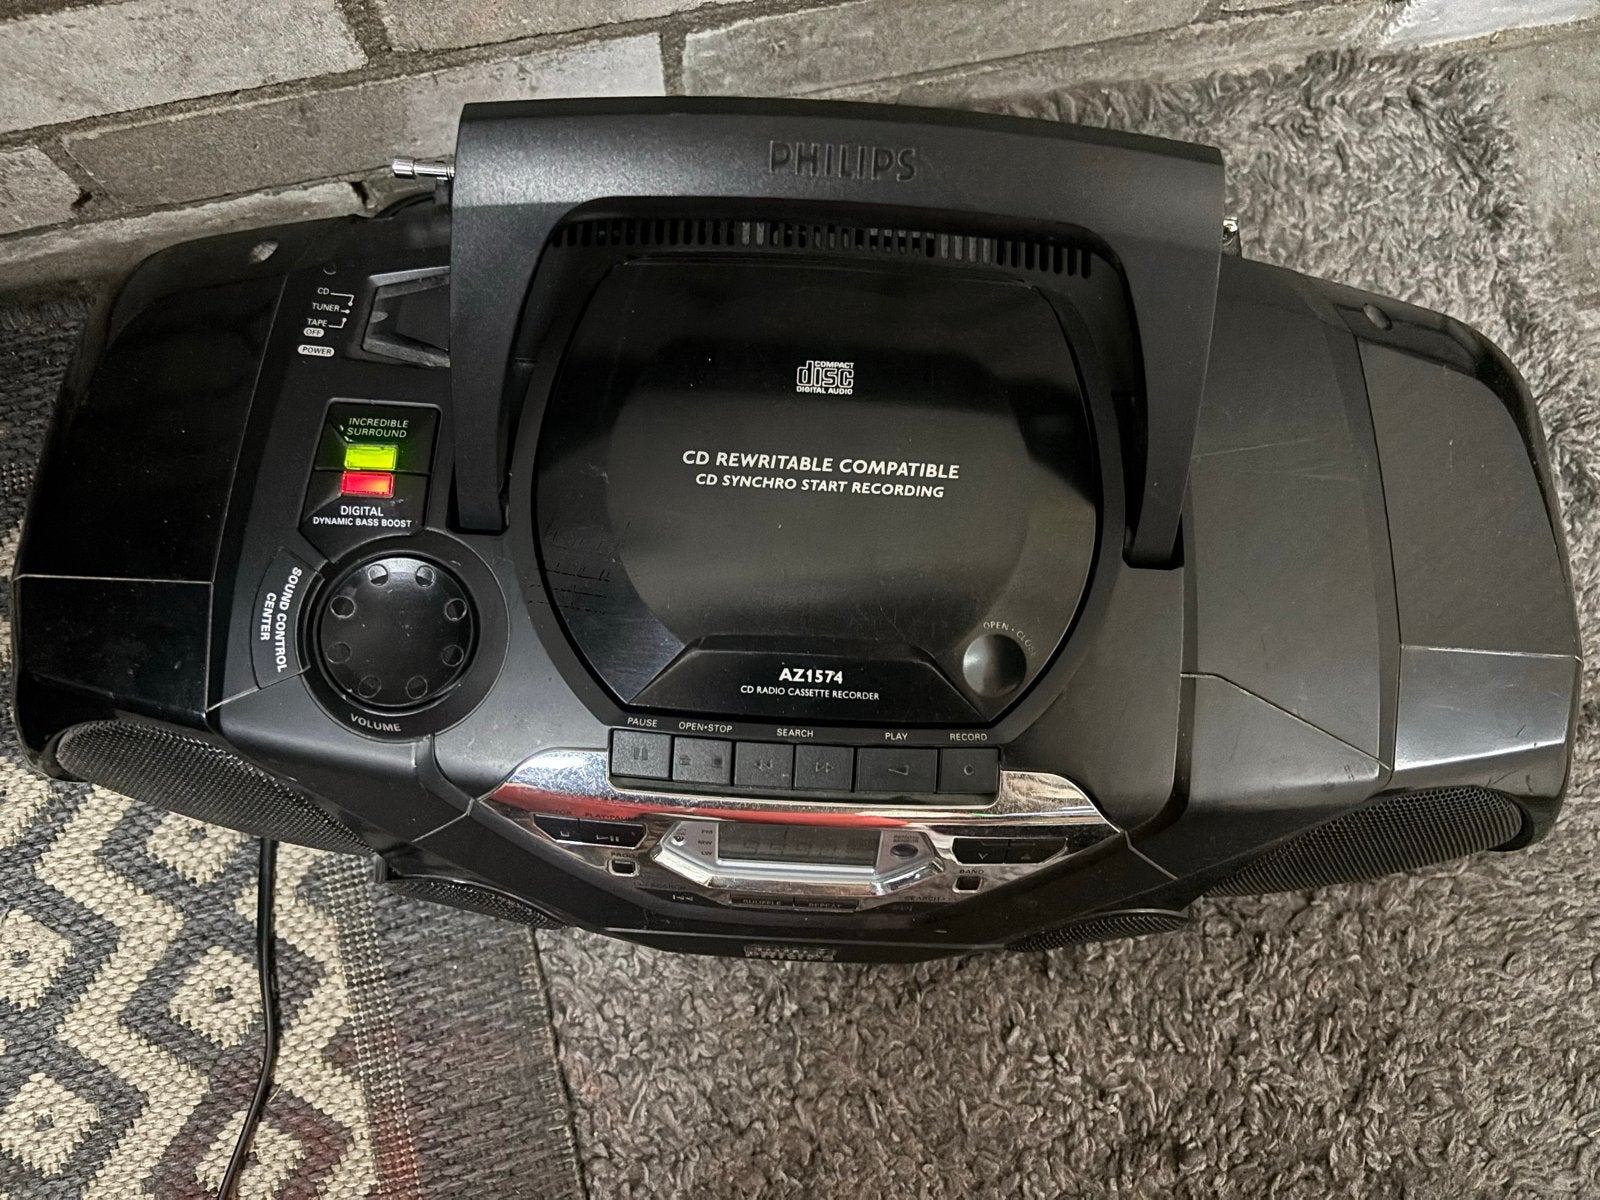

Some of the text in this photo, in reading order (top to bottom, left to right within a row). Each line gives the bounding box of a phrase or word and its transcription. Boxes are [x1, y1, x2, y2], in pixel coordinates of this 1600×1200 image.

[769, 140, 917, 182] PHILIPS
[317, 287, 330, 296] CD
[312, 302, 341, 312] TUNER
[307, 318, 328, 327] TAPE
[305, 329, 322, 337] OFF
[302, 346, 332, 355] POWER
[815, 361, 854, 369] COMPACT
[796, 386, 853, 395] DIGITAL AUDIO
[349, 417, 409, 428] INCREDIBLE
[347, 427, 407, 438] SURROUND
[682, 450, 960, 479] CD REWRITABLE COMPATIBLE
[695, 473, 945, 498] CD SYNCHRO START RECORDING
[340, 505, 384, 516] DIGITAL
[313, 517, 412, 528] DYNAMIC BASS BOOST
[260, 592, 277, 641] CENTER
[275, 567, 302, 673] SOUND CONTROL
[779, 668, 843, 684] AZ1574
[740, 685, 880, 701] CD RADIO CASSETTE RECORDER
[351, 713, 402, 732] VOLUME
[627, 717, 658, 727] PAUSE
[776, 728, 814, 738] SEARCH
[885, 732, 908, 740] PLAY
[950, 733, 987, 741] RECORD
